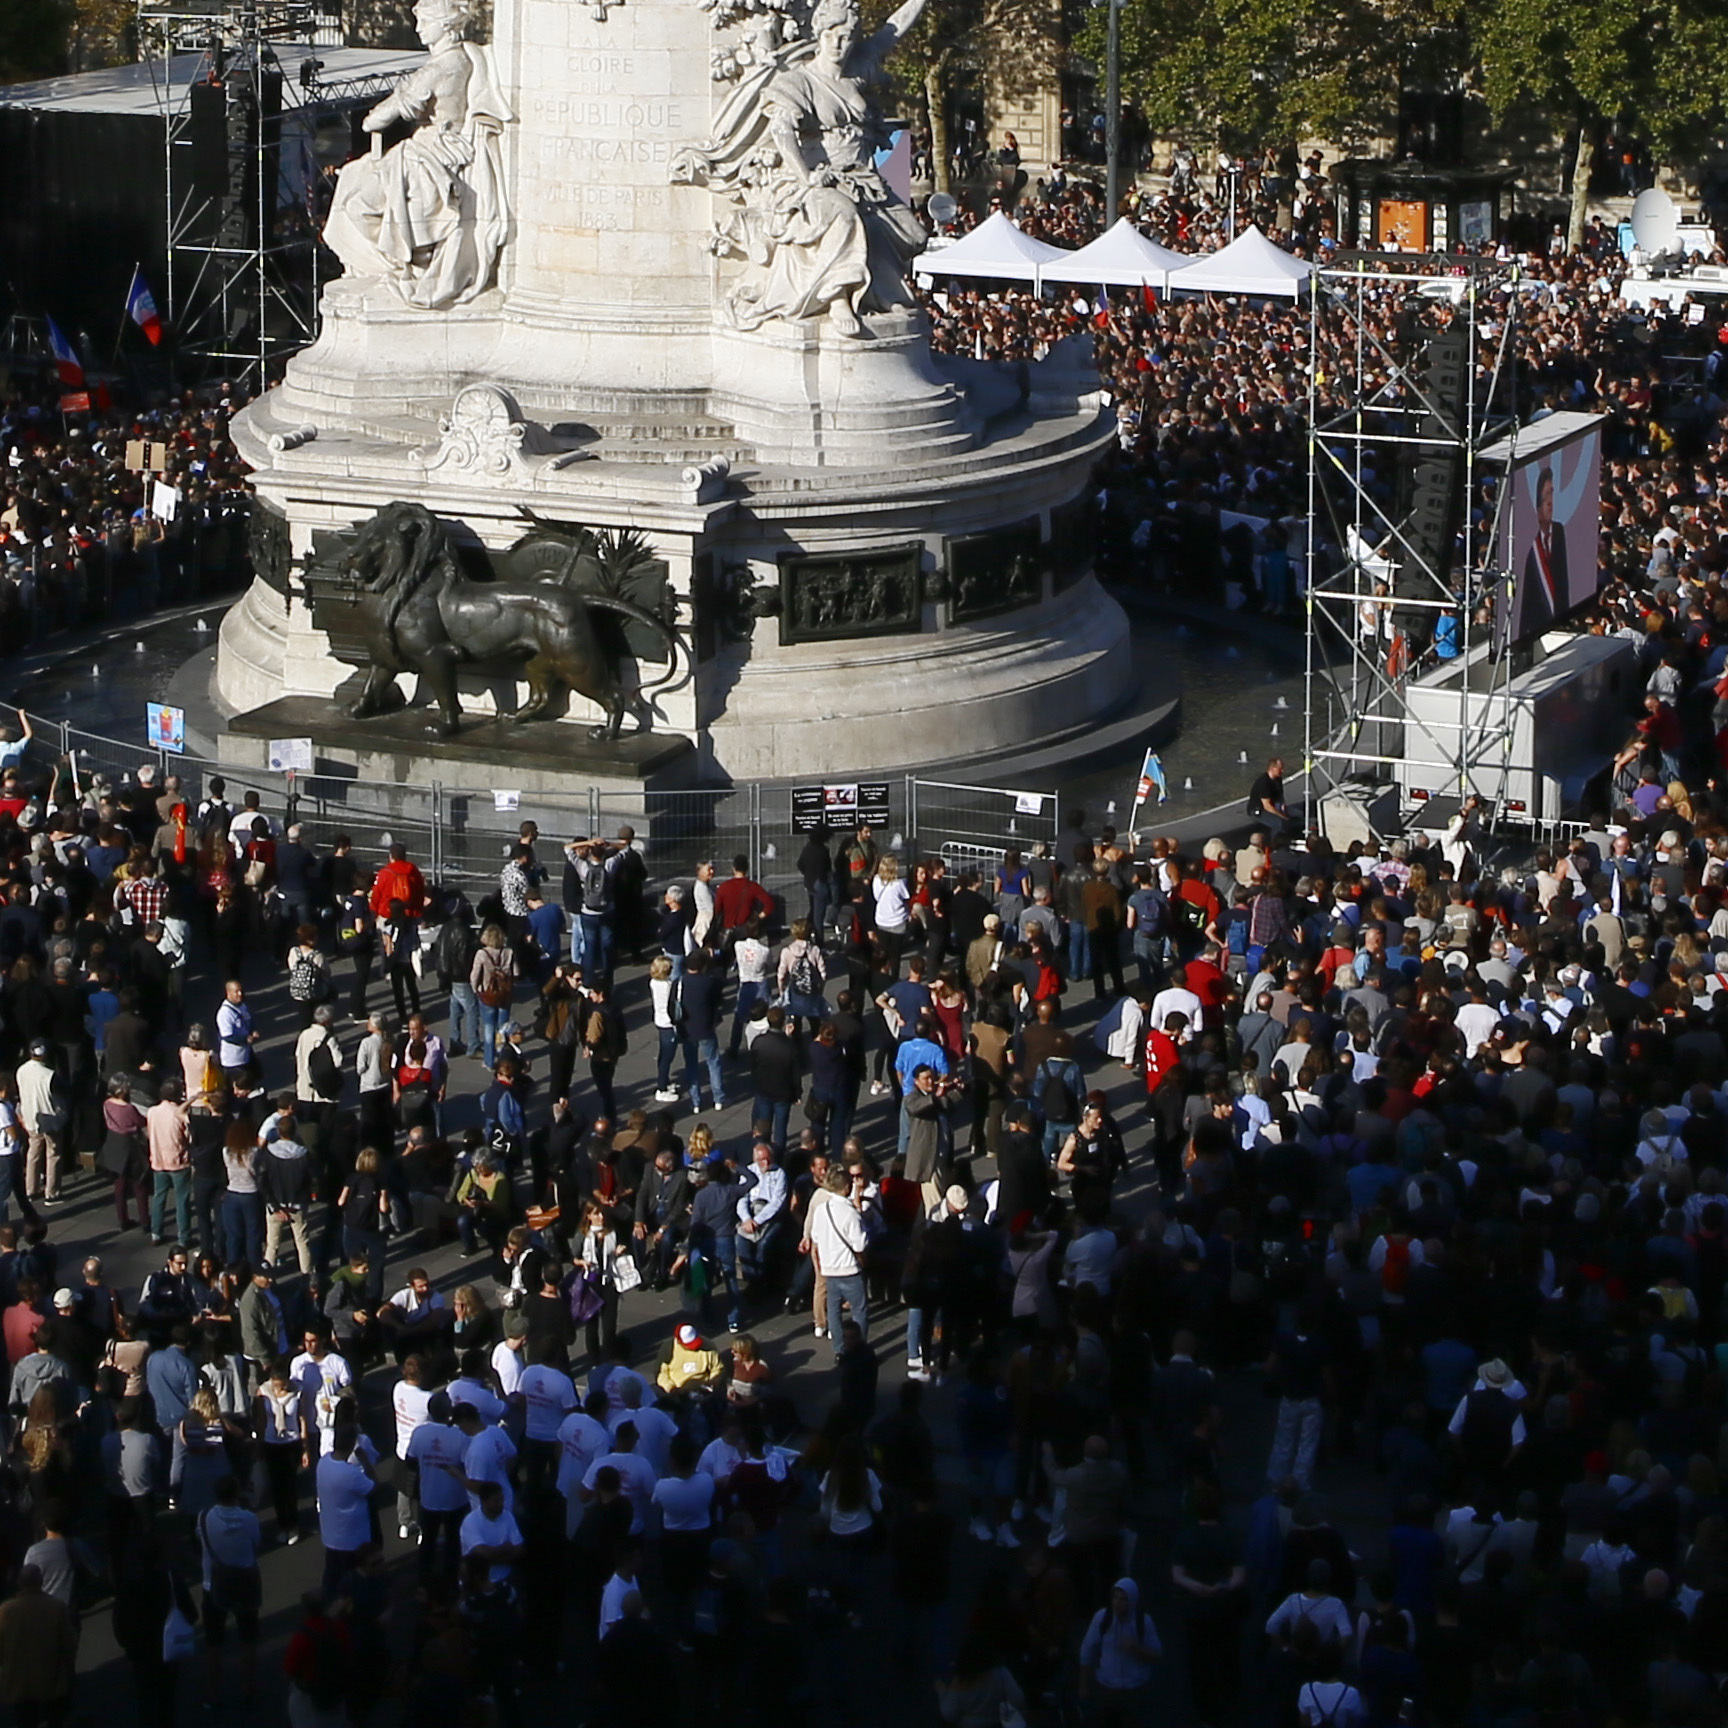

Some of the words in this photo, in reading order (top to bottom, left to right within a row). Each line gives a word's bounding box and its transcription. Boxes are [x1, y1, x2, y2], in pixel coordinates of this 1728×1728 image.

[566, 56, 634, 74] GLOIRE
[587, 187, 610, 205] DE
[615, 189, 664, 207] PARIS
[579, 210, 618, 229] 1883
